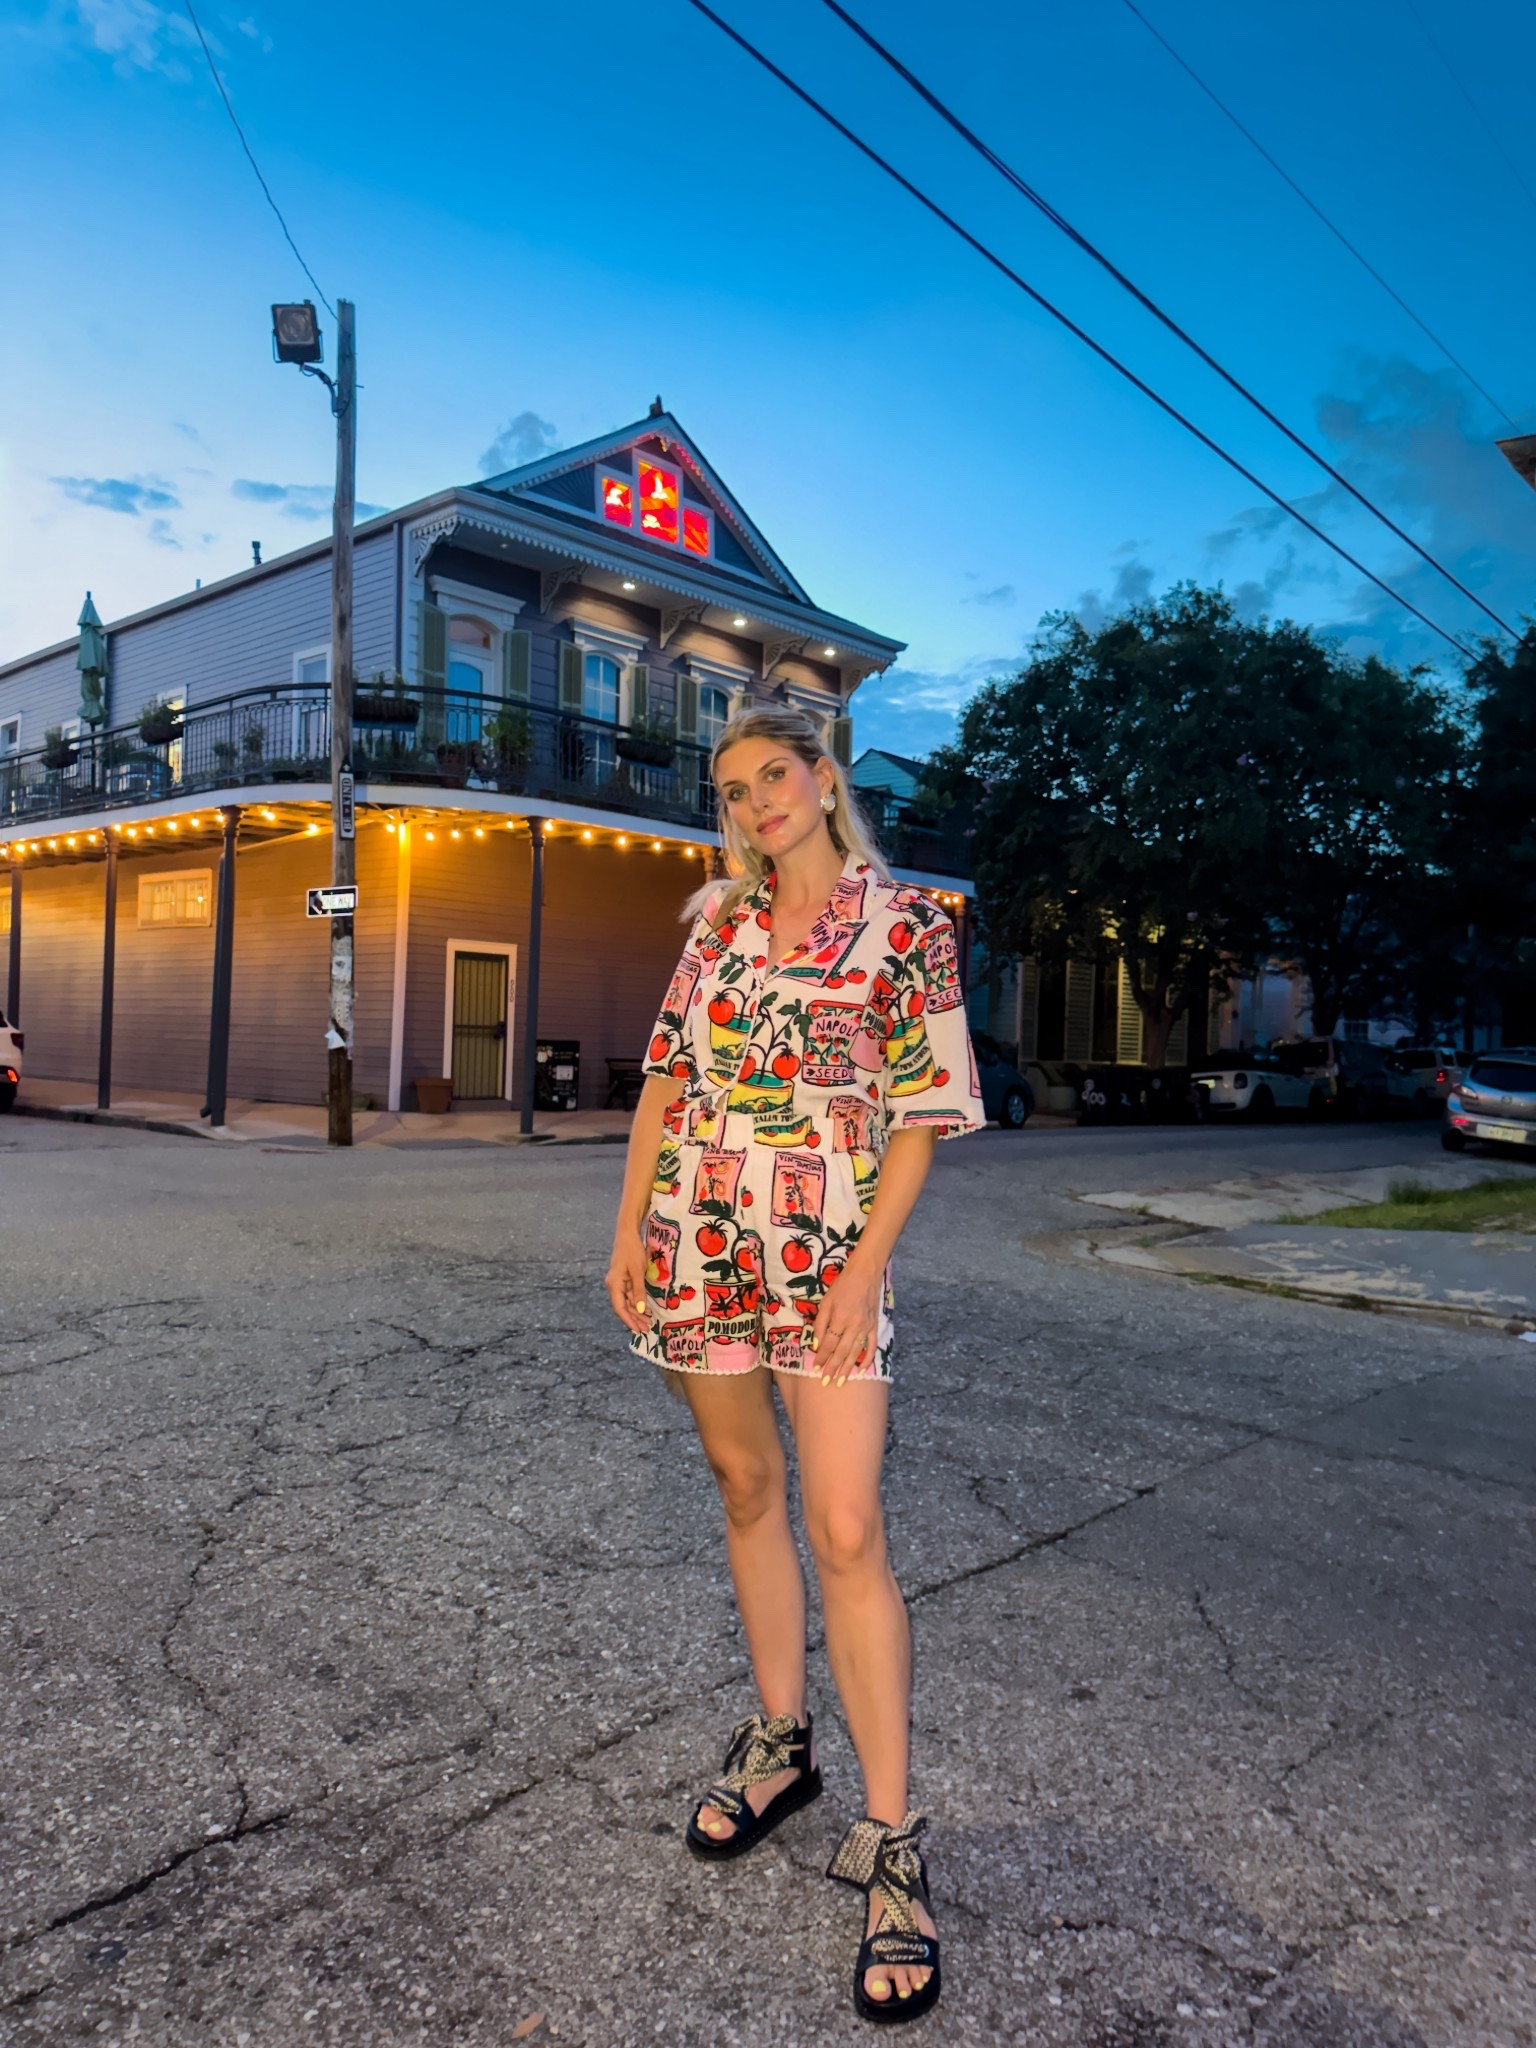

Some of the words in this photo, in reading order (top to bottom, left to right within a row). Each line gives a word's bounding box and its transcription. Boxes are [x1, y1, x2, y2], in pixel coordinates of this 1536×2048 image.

[342, 777, 352, 804] KIND
[343, 817, 352, 830] BE
[337, 895, 352, 906] WAY
